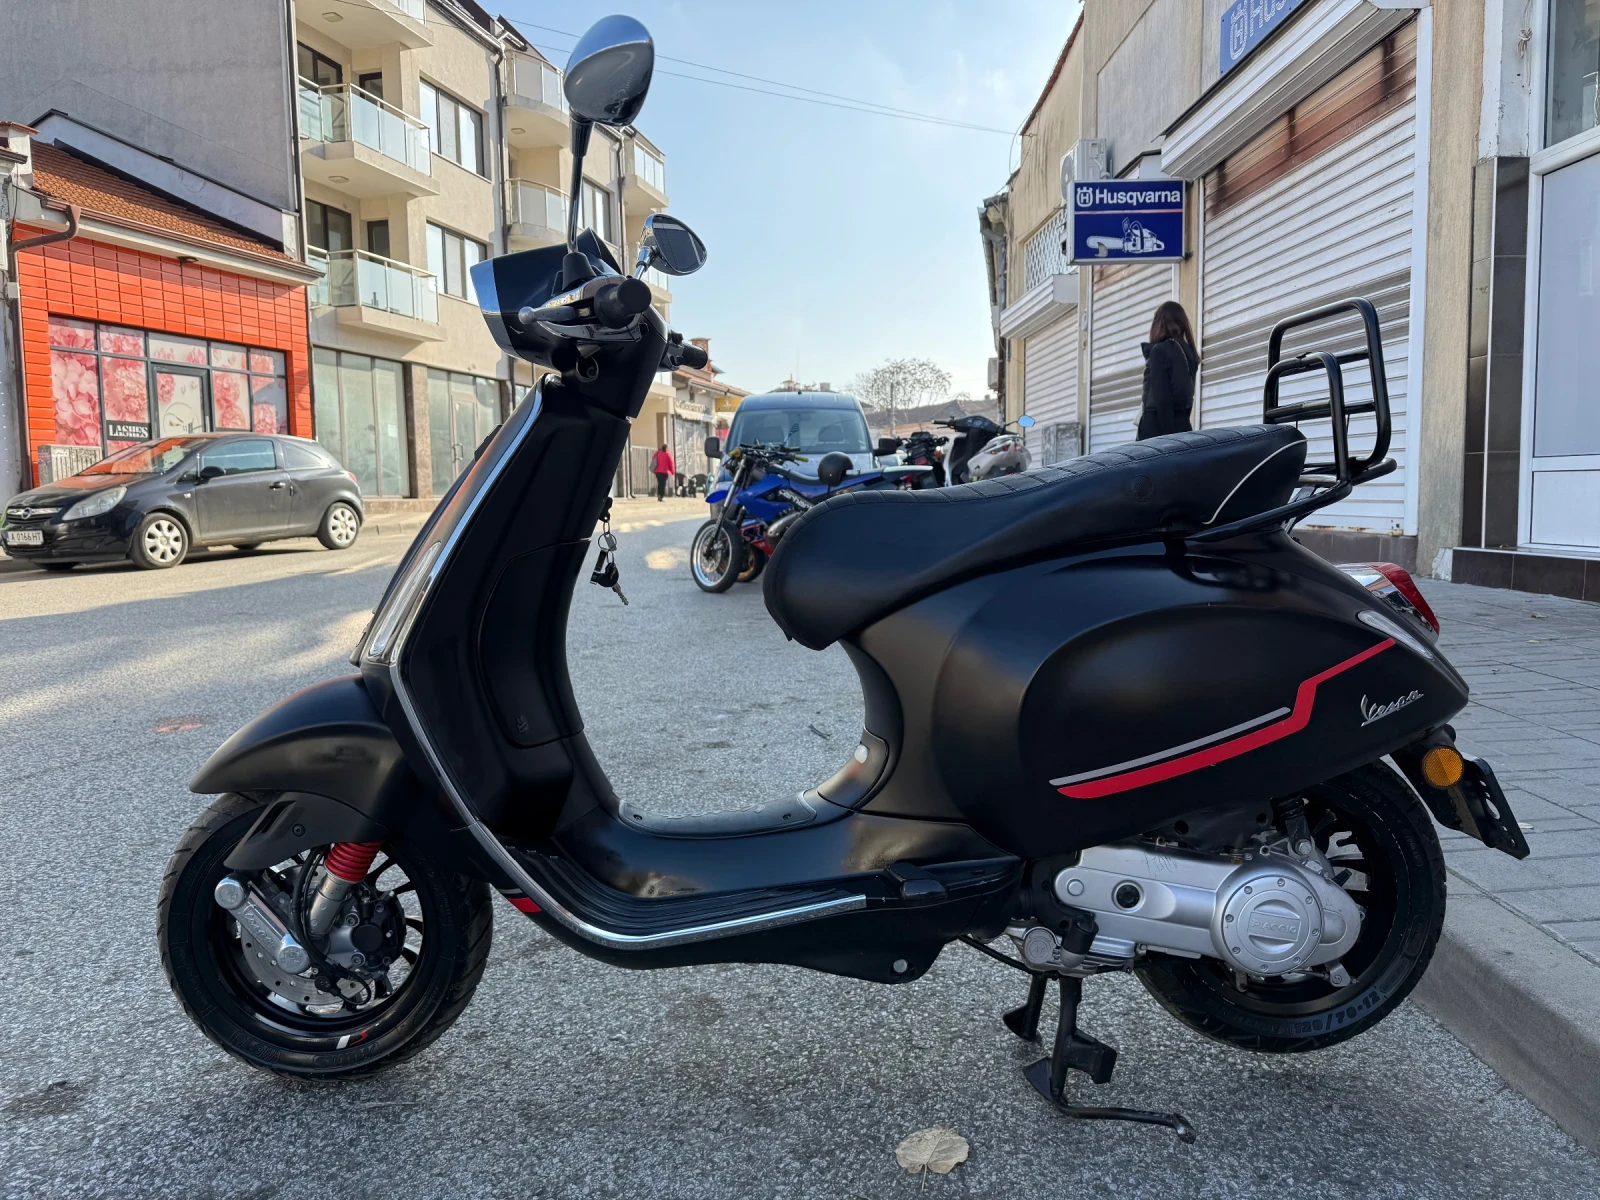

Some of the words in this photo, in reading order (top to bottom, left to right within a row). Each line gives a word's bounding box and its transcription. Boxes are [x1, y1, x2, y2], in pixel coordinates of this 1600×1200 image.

[1095, 188, 1181, 206] Husqvarna
[108, 424, 149, 439] LASHES
[11, 532, 16, 541] A
[32, 532, 41, 541] HT
[1360, 690, 1425, 727] Vespa
[1251, 919, 1298, 934] PIAGGIO
